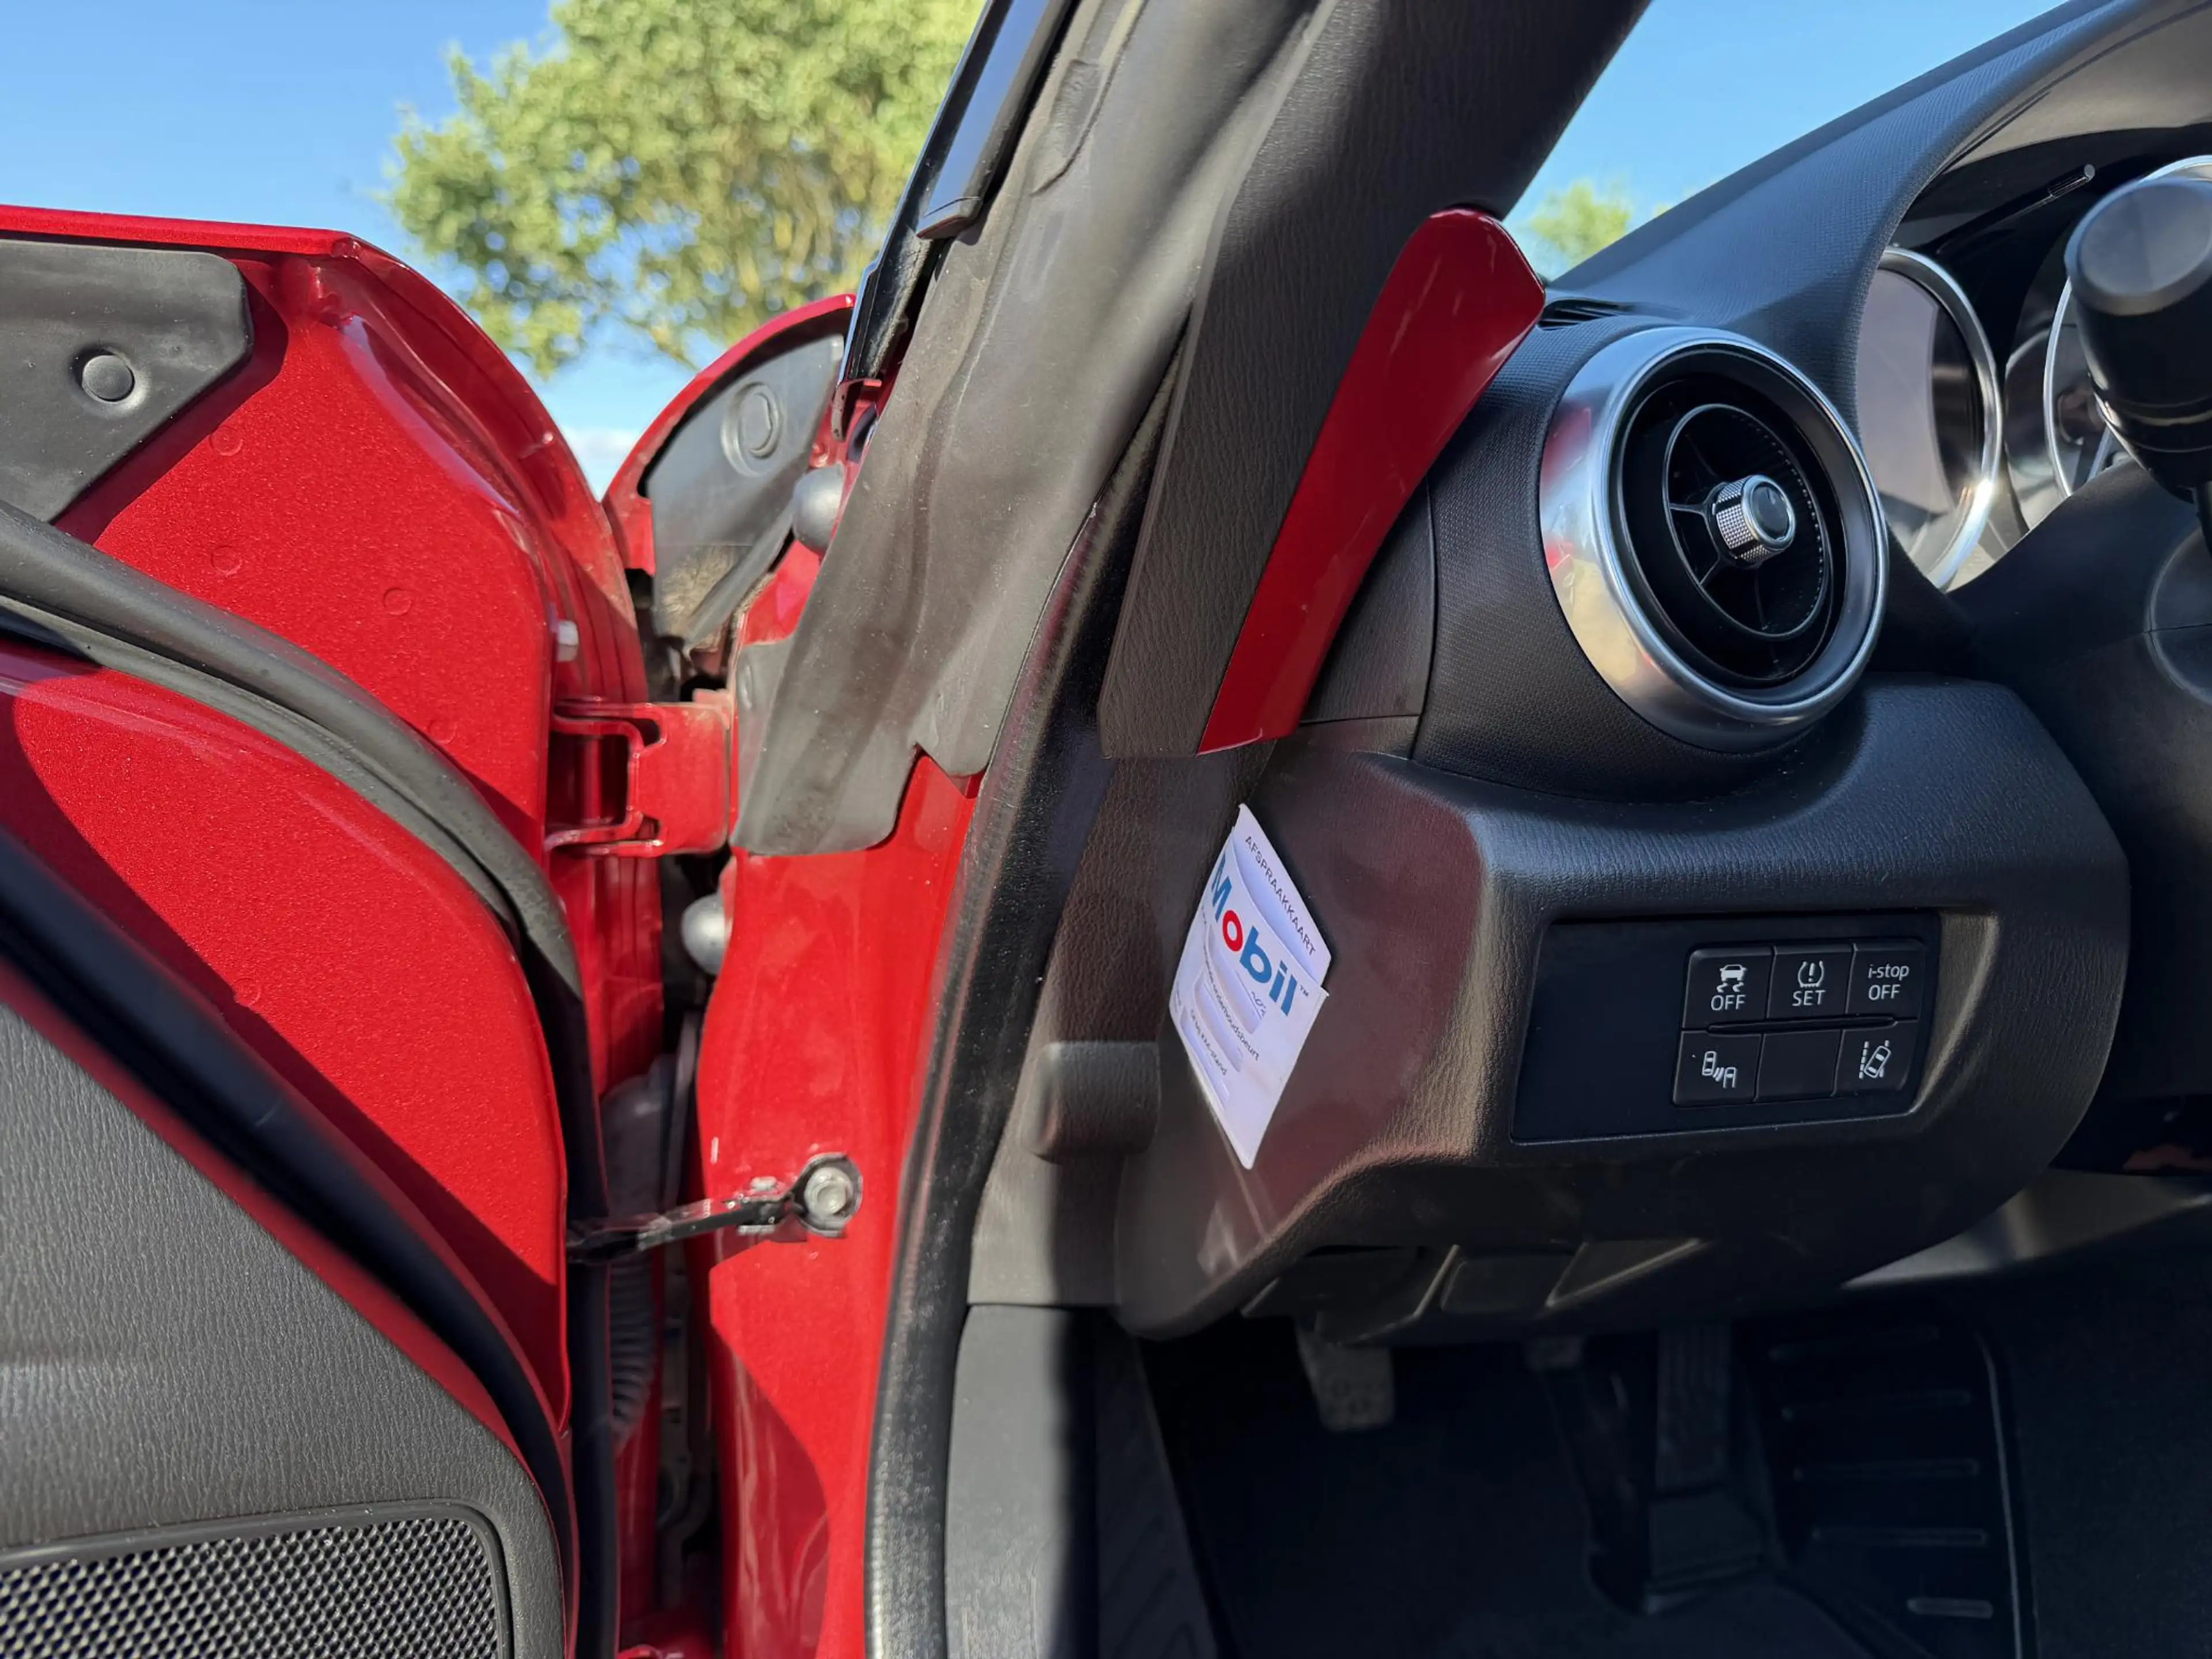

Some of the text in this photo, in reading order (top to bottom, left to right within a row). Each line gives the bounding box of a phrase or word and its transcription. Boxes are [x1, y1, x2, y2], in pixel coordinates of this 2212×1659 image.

[1245, 836, 1316, 956] AFSPRAAKKAART
[1211, 853, 1298, 1016] Mobil
[1868, 963, 1910, 980] i-stop
[1792, 990, 1826, 1006] SET
[1868, 984, 1900, 1001] OFF
[1710, 994, 1746, 1011] OFF
